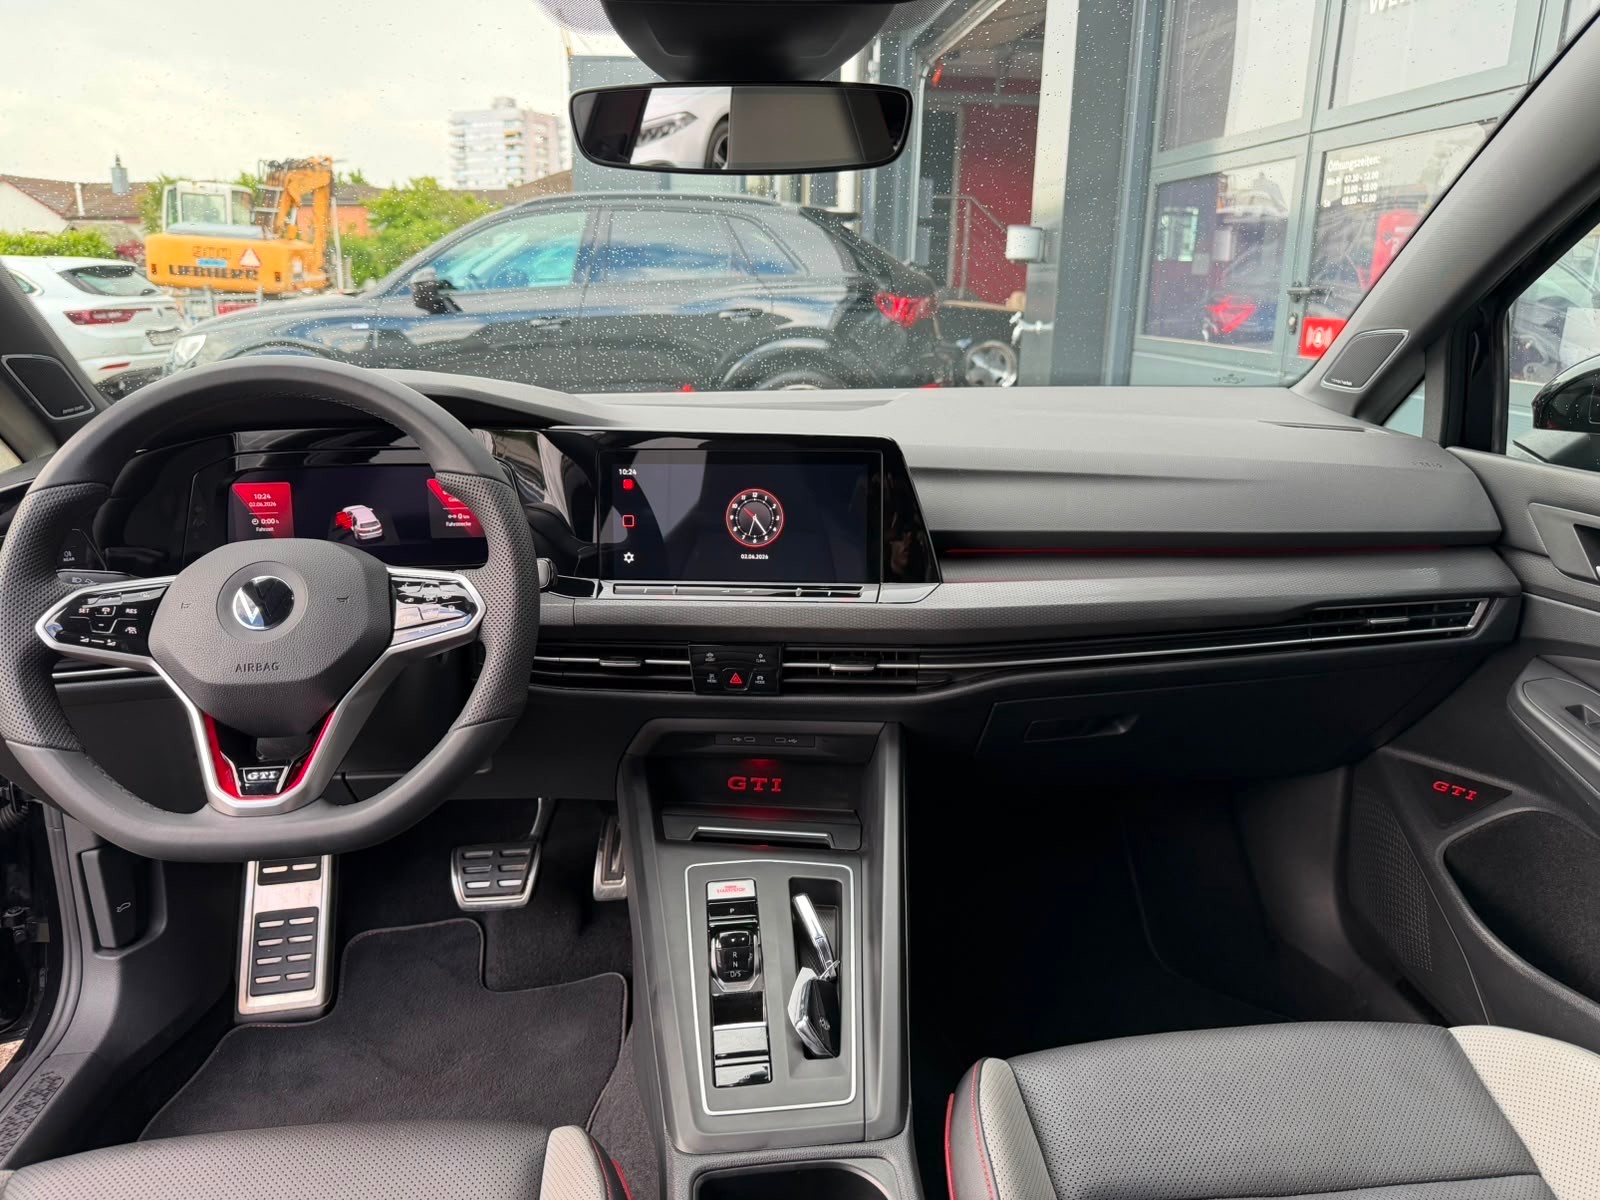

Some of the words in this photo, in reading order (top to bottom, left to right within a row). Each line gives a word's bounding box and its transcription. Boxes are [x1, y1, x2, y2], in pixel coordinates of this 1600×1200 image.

[235, 661, 280, 673] AIRBAG
[247, 770, 278, 780] GTI
[727, 776, 782, 792] GTI
[1432, 780, 1478, 801] GTI
[732, 951, 738, 959] R
[730, 970, 741, 978] D/S
